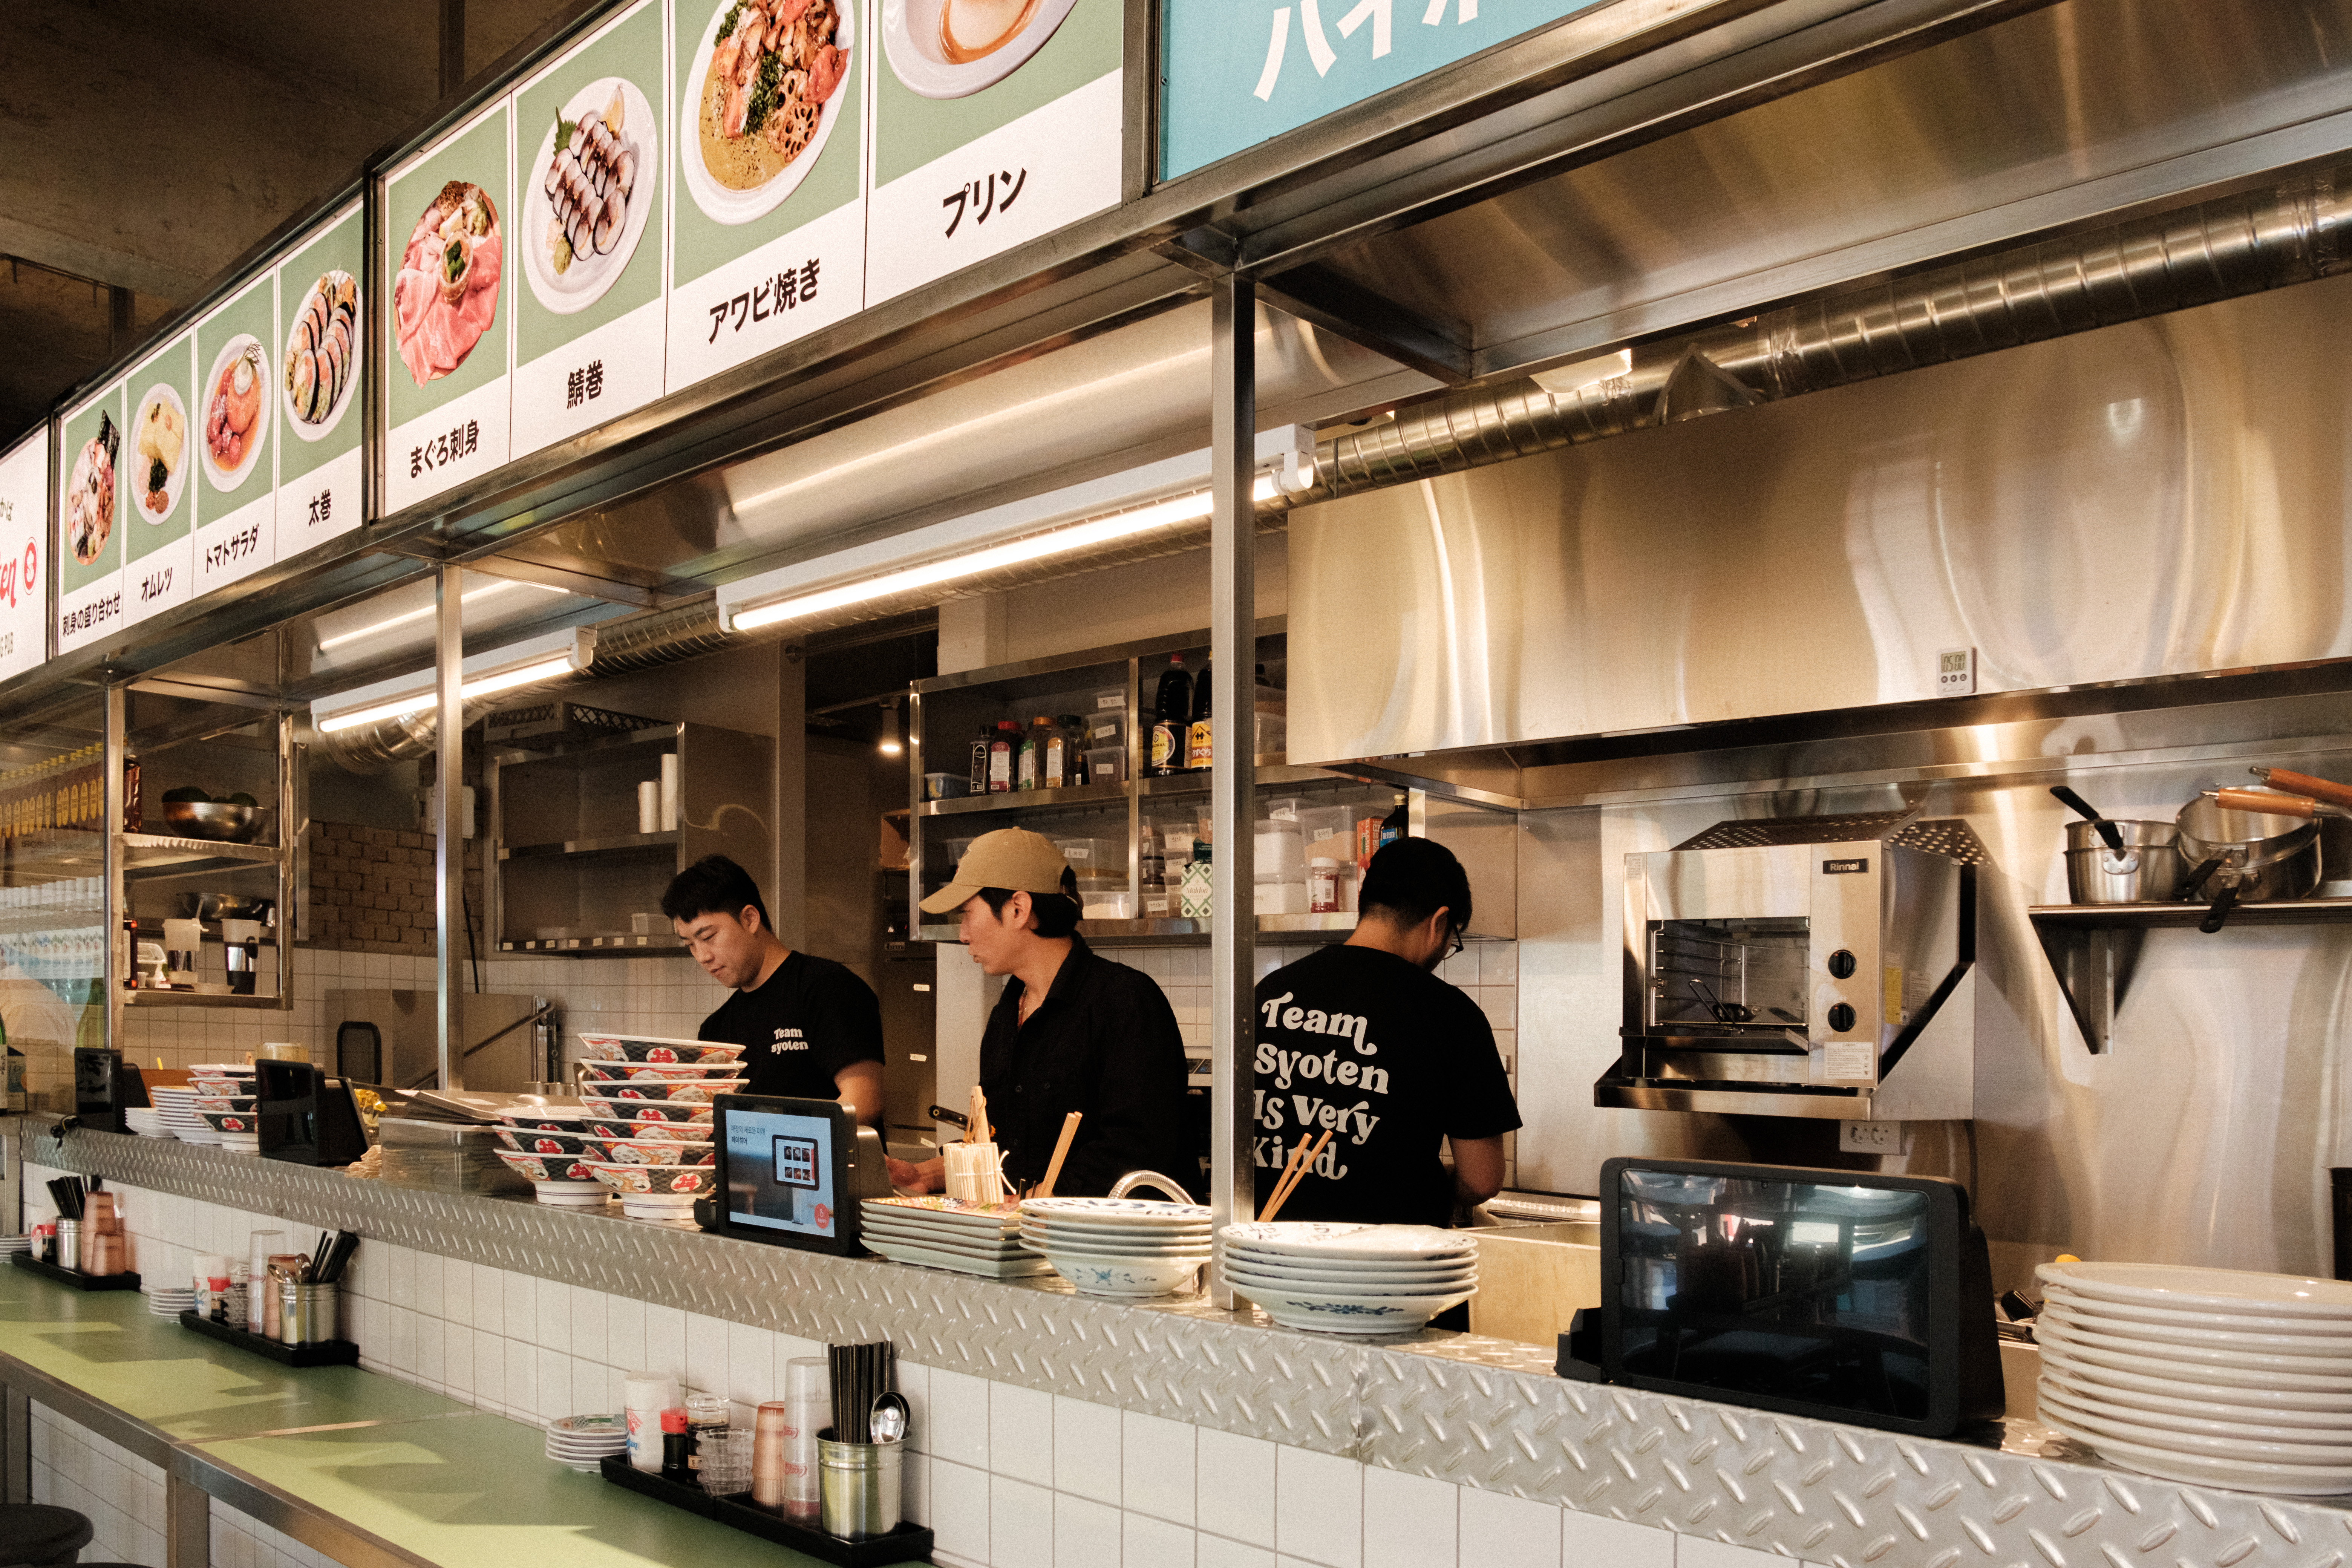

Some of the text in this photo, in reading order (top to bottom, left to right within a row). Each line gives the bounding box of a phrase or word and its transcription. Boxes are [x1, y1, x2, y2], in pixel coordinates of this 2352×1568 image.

[943, 167, 1027, 239] プリン
[709, 257, 820, 345] アワビ焼き
[567, 359, 603, 410] 鯖巻
[410, 419, 479, 479] まぐろ刺身
[308, 488, 331, 527] 太巻
[207, 522, 260, 573] トマトサラダ
[141, 567, 173, 602] オムレツ
[63, 591, 121, 638] 刺身の盛り合わせ
[1830, 861, 1859, 871] Rinnai
[774, 1027, 803, 1040] Team
[1261, 991, 1378, 1055] Team
[1292, 1094, 1380, 1145] Very
